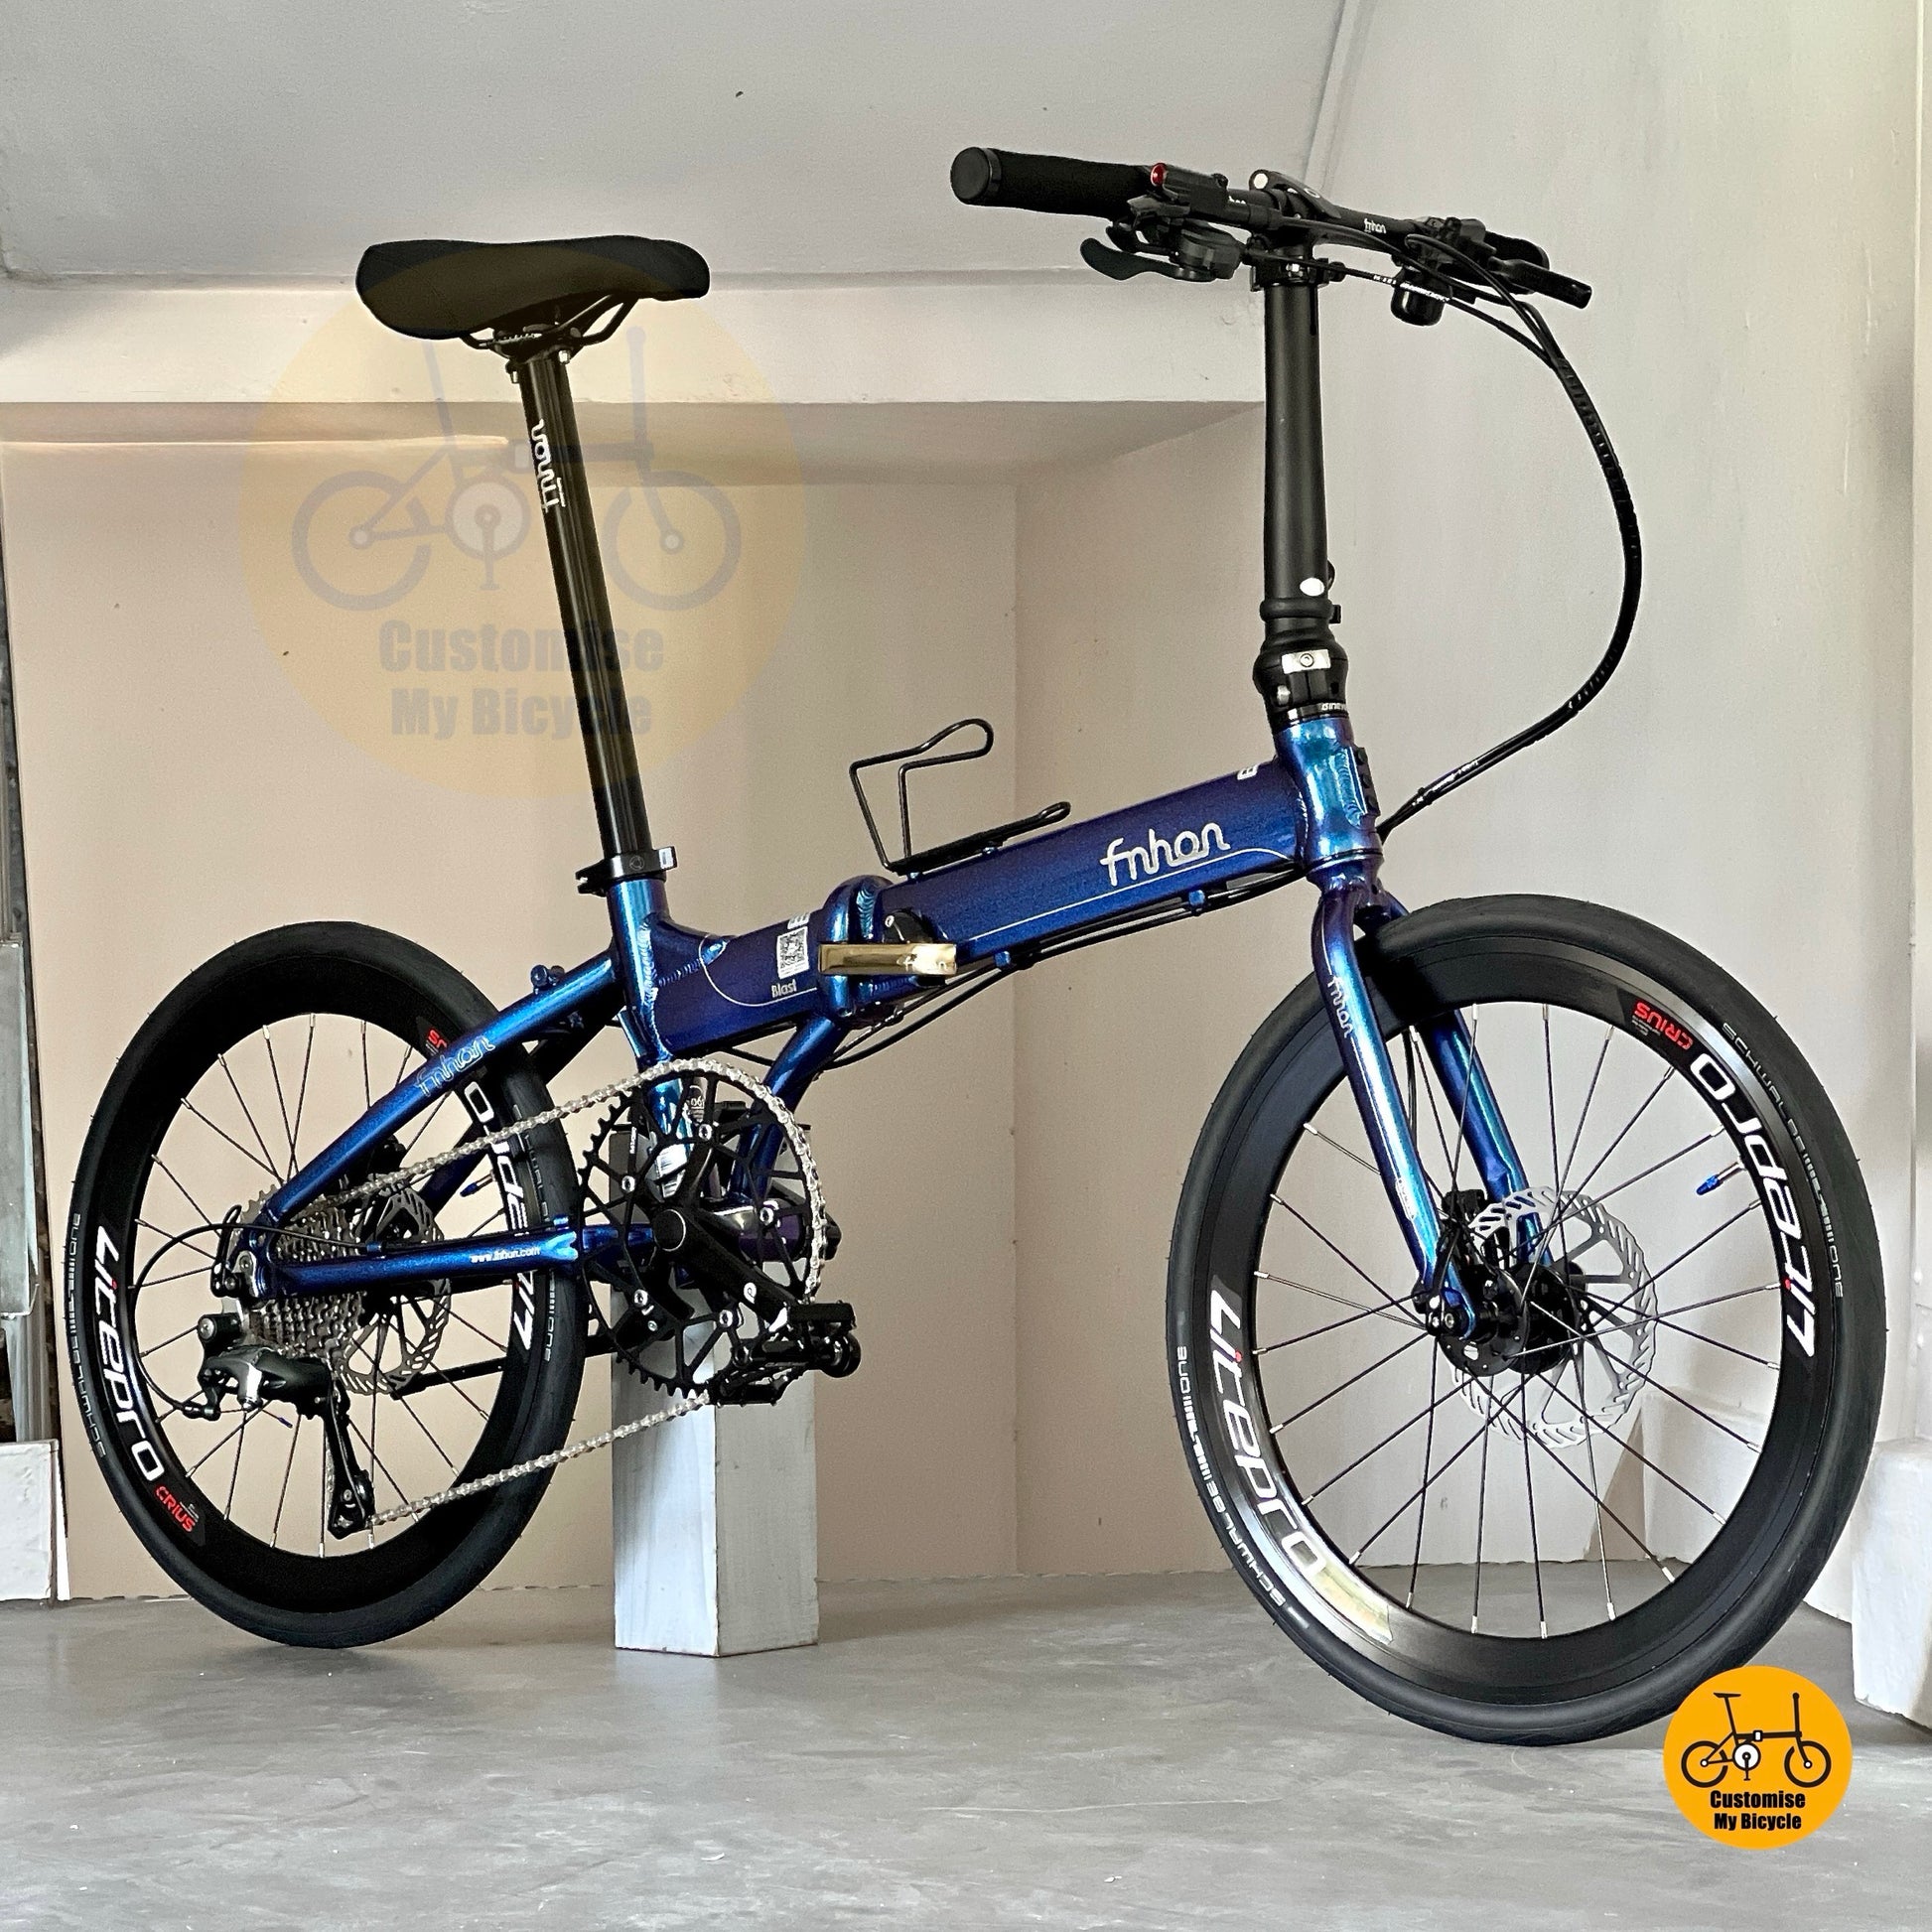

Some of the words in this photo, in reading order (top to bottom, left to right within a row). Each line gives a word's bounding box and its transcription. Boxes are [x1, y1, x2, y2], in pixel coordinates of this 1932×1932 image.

[1099, 822, 1231, 887] fnhon
[770, 978, 797, 999] Blast
[1633, 1001, 1694, 1051] CRIUS
[1721, 1022, 1807, 1155] SCHWALBE
[155, 1485, 197, 1533] CRIUS
[1205, 1479, 1287, 1607] SCHWALBE
